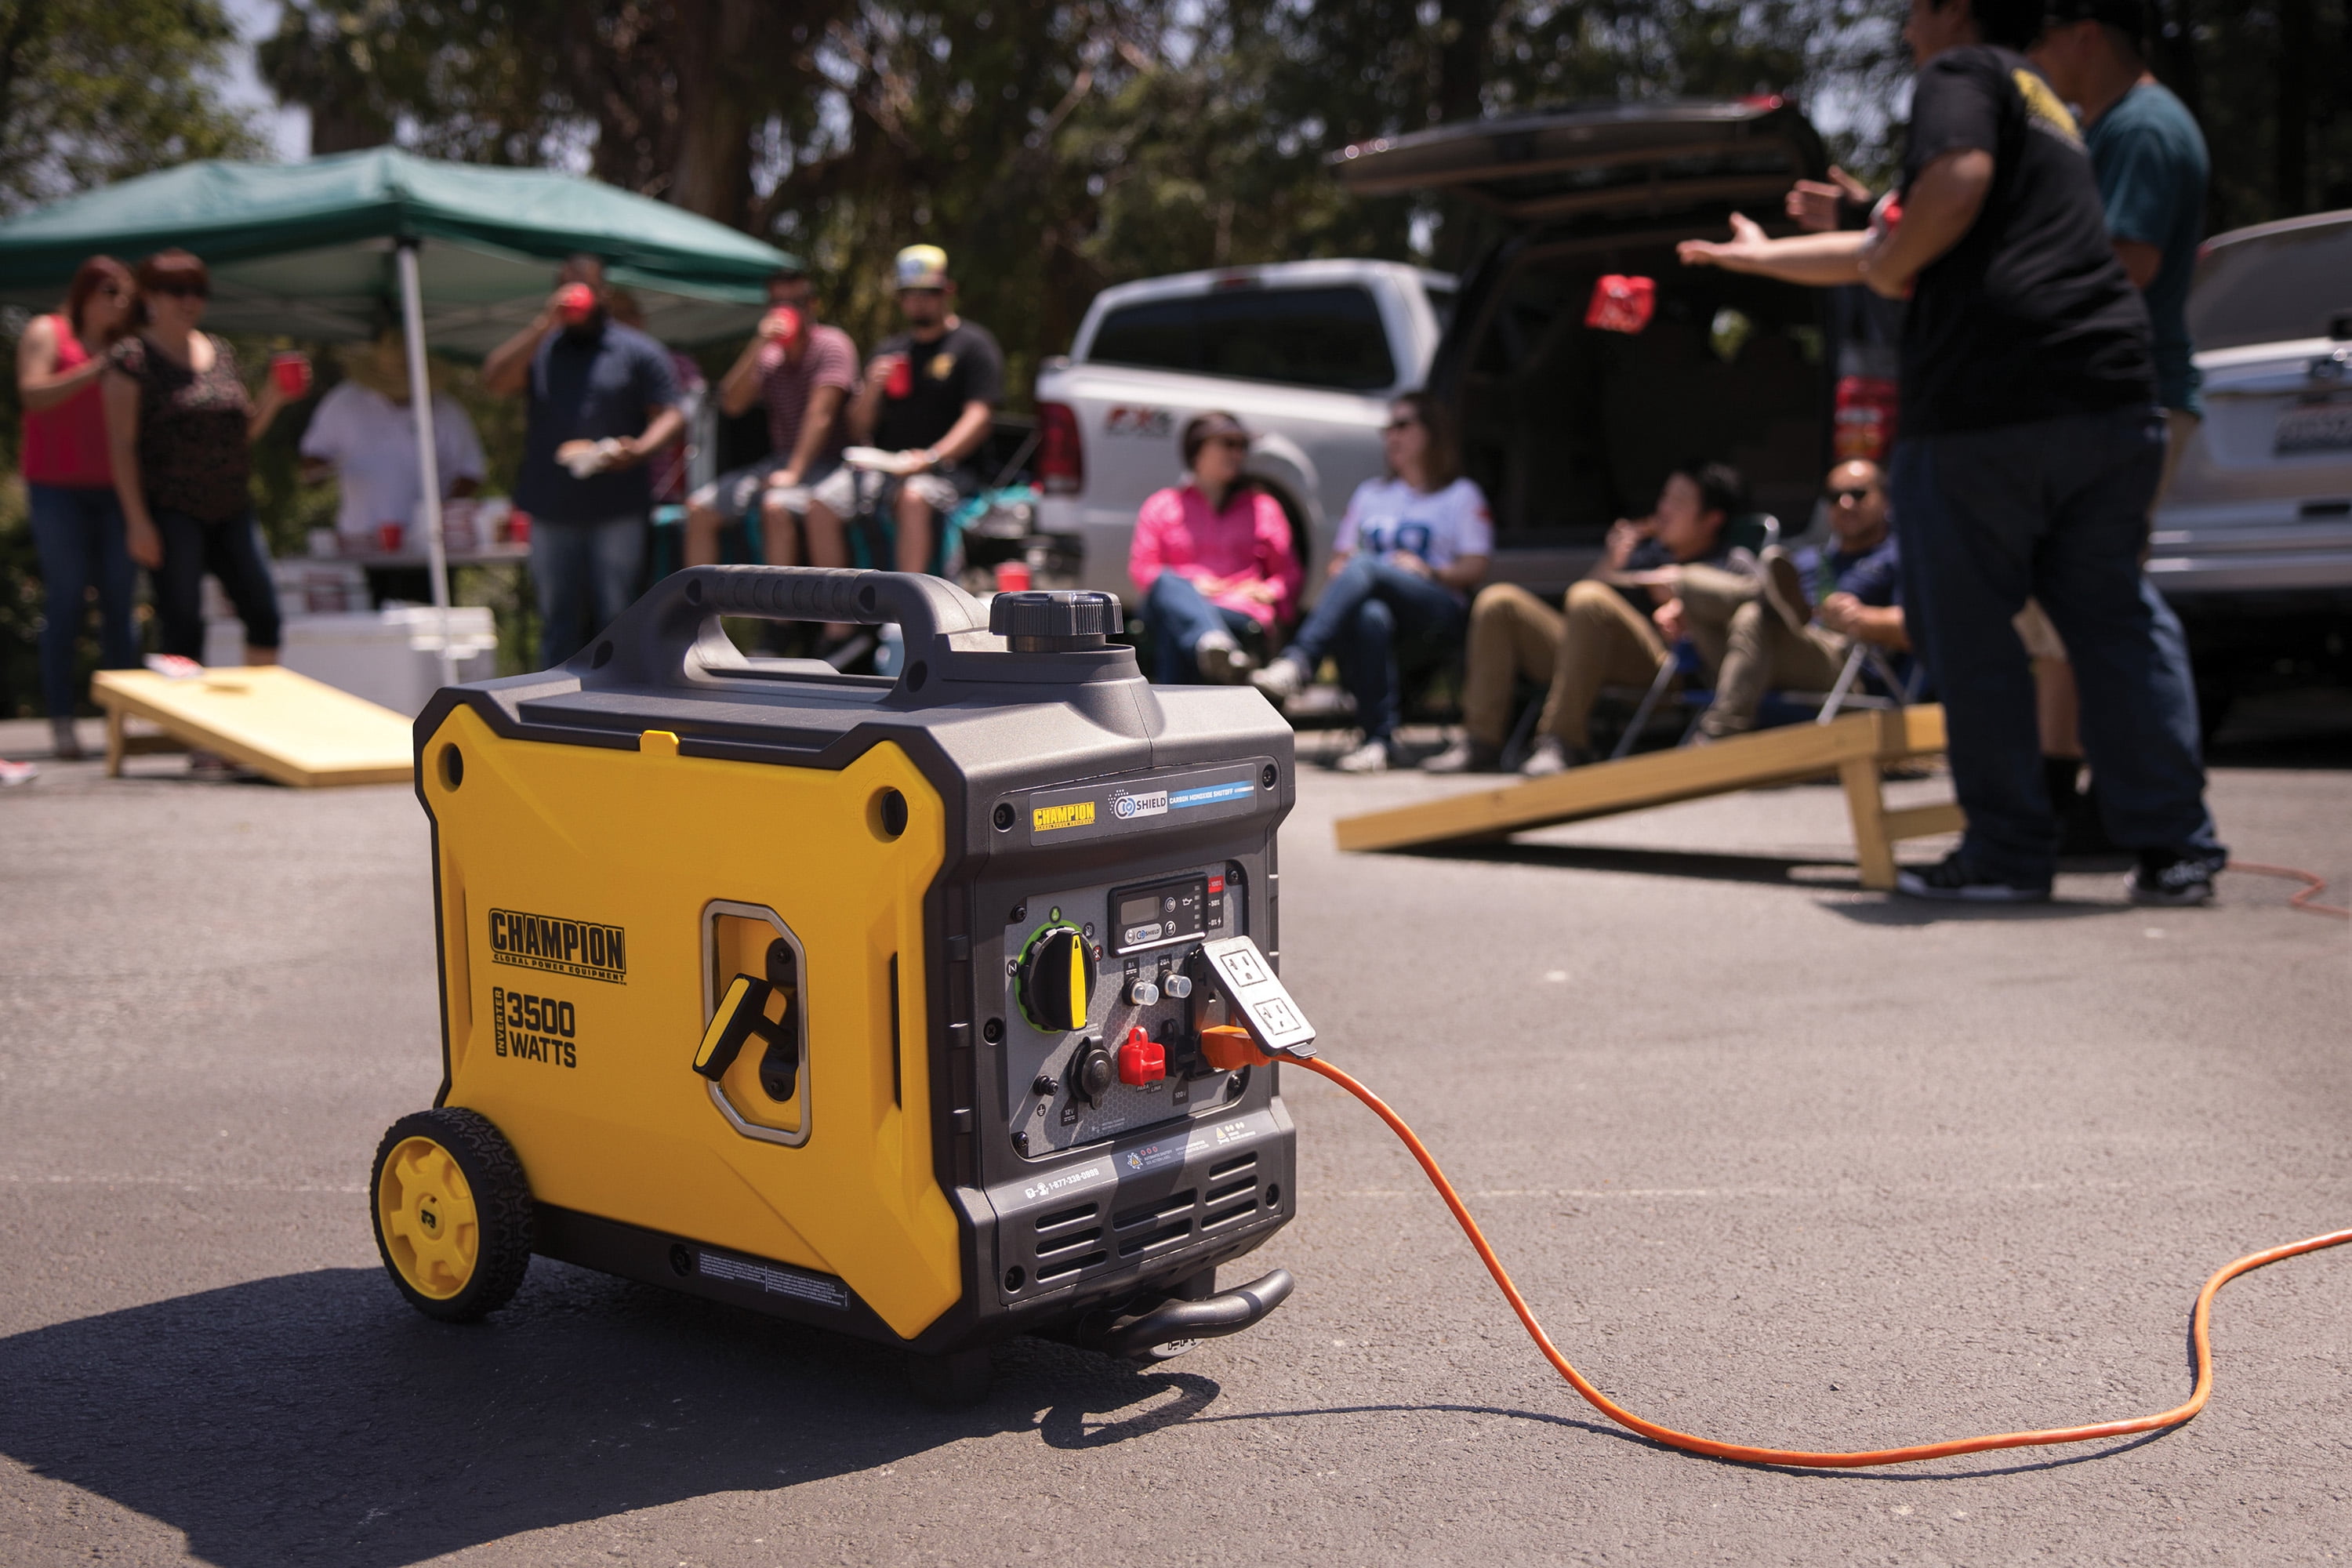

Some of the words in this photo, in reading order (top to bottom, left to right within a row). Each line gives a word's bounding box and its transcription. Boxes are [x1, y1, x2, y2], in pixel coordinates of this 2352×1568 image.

[1136, 797, 1167, 811] SHIELD
[1169, 795, 1189, 804] CARBON
[1189, 791, 1213, 800] MONOXIDE
[1213, 788, 1233, 797] SHUTOFF
[1034, 803, 1094, 826] CHAMPION
[490, 912, 624, 970] CHAMPION
[494, 953, 529, 966] GLOBAL
[532, 960, 564, 971] POWER
[568, 966, 625, 982] EQUIPMENT
[495, 989, 506, 1054] INVERTER
[507, 992, 575, 1038] 3500
[509, 1031, 576, 1069] WATTS
